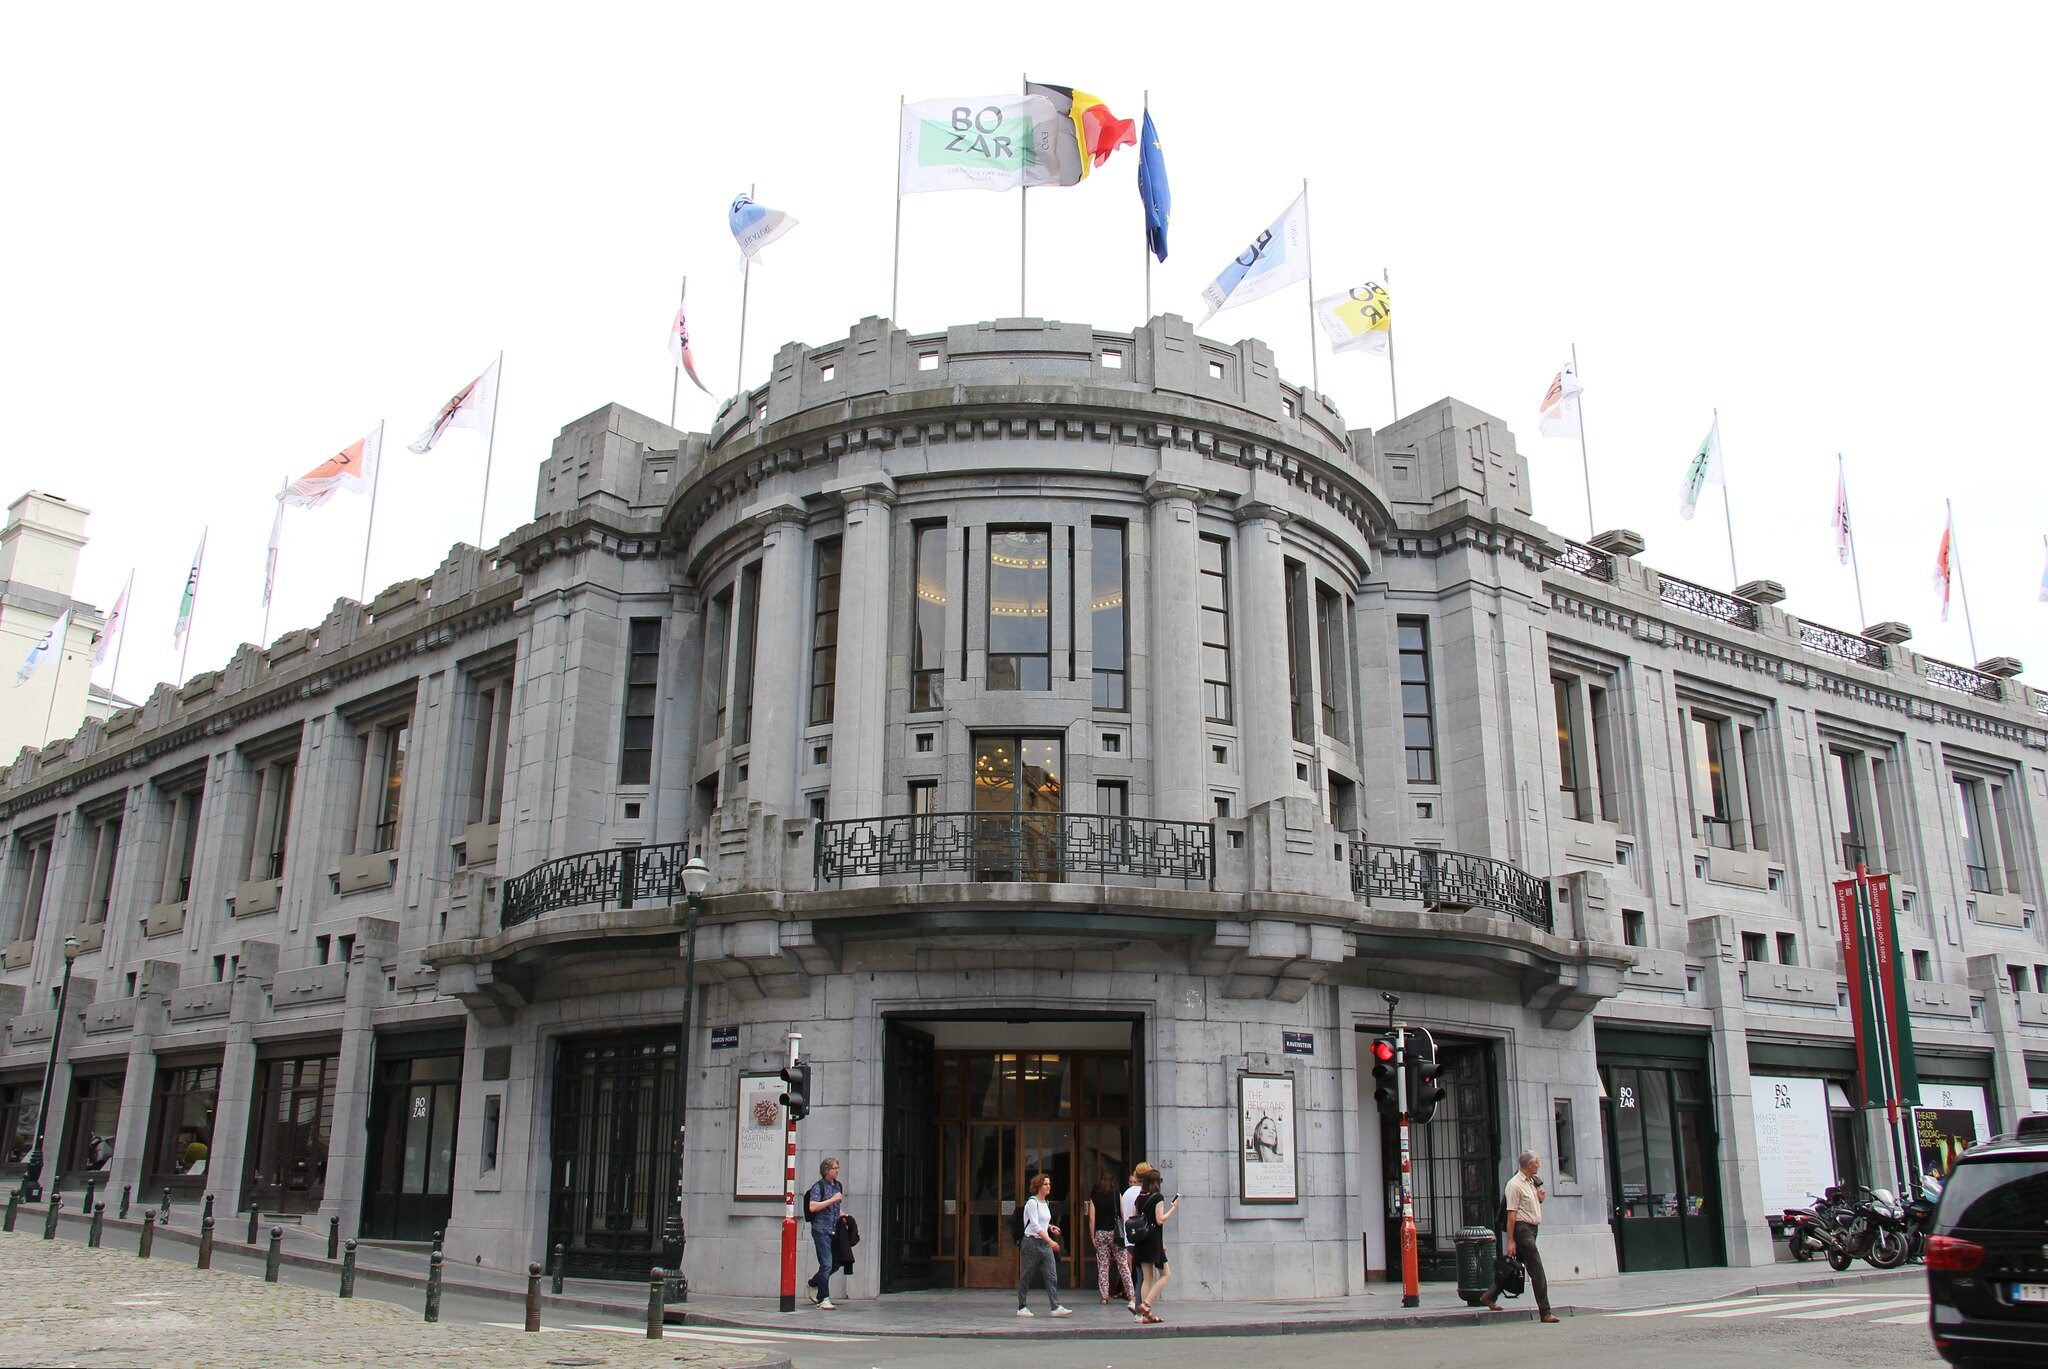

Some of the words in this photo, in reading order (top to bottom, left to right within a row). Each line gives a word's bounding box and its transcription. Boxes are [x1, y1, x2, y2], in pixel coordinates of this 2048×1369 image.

[952, 106, 1002, 134] BO
[945, 134, 1013, 159] ZAR
[1838, 889, 1847, 921] Beaux-Arts
[1286, 1041, 1312, 1049] RAVENSTEIN
[1620, 1087, 1632, 1098] BO
[1775, 1084, 1788, 1096] BO
[1942, 1090, 1951, 1099] BO
[1248, 1091, 1264, 1100] THE
[415, 1097, 425, 1107] BO
[1248, 1101, 1285, 1110] BELGIANS
[1620, 1097, 1635, 1108] ZAR
[1775, 1097, 1792, 1109] ZAR
[413, 1107, 426, 1117] ZAR
[1916, 1111, 1937, 1120] THEATER
[1761, 1125, 1778, 1135] 2015
[1926, 1121, 1933, 1129] DE
